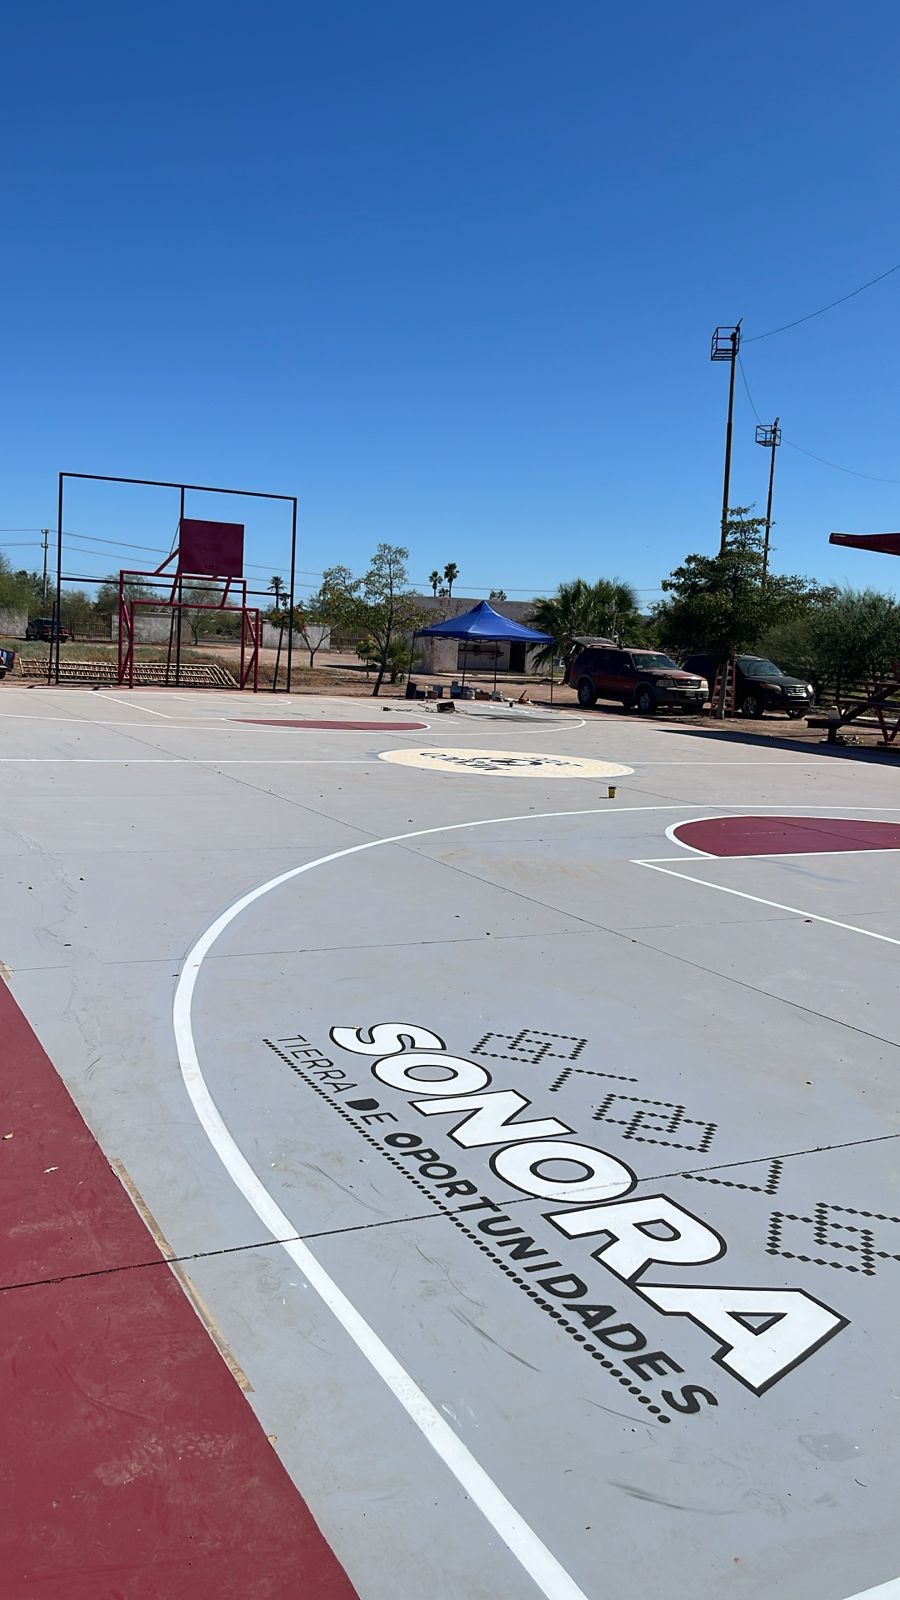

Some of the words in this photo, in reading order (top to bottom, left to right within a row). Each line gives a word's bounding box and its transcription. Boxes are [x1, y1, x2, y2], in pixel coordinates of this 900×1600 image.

[277, 1034, 358, 1094] TIERRA
[344, 1098, 399, 1126] DE
[384, 1132, 719, 1414] OPORTUNIDADES
[329, 1022, 851, 1397] SONORA
